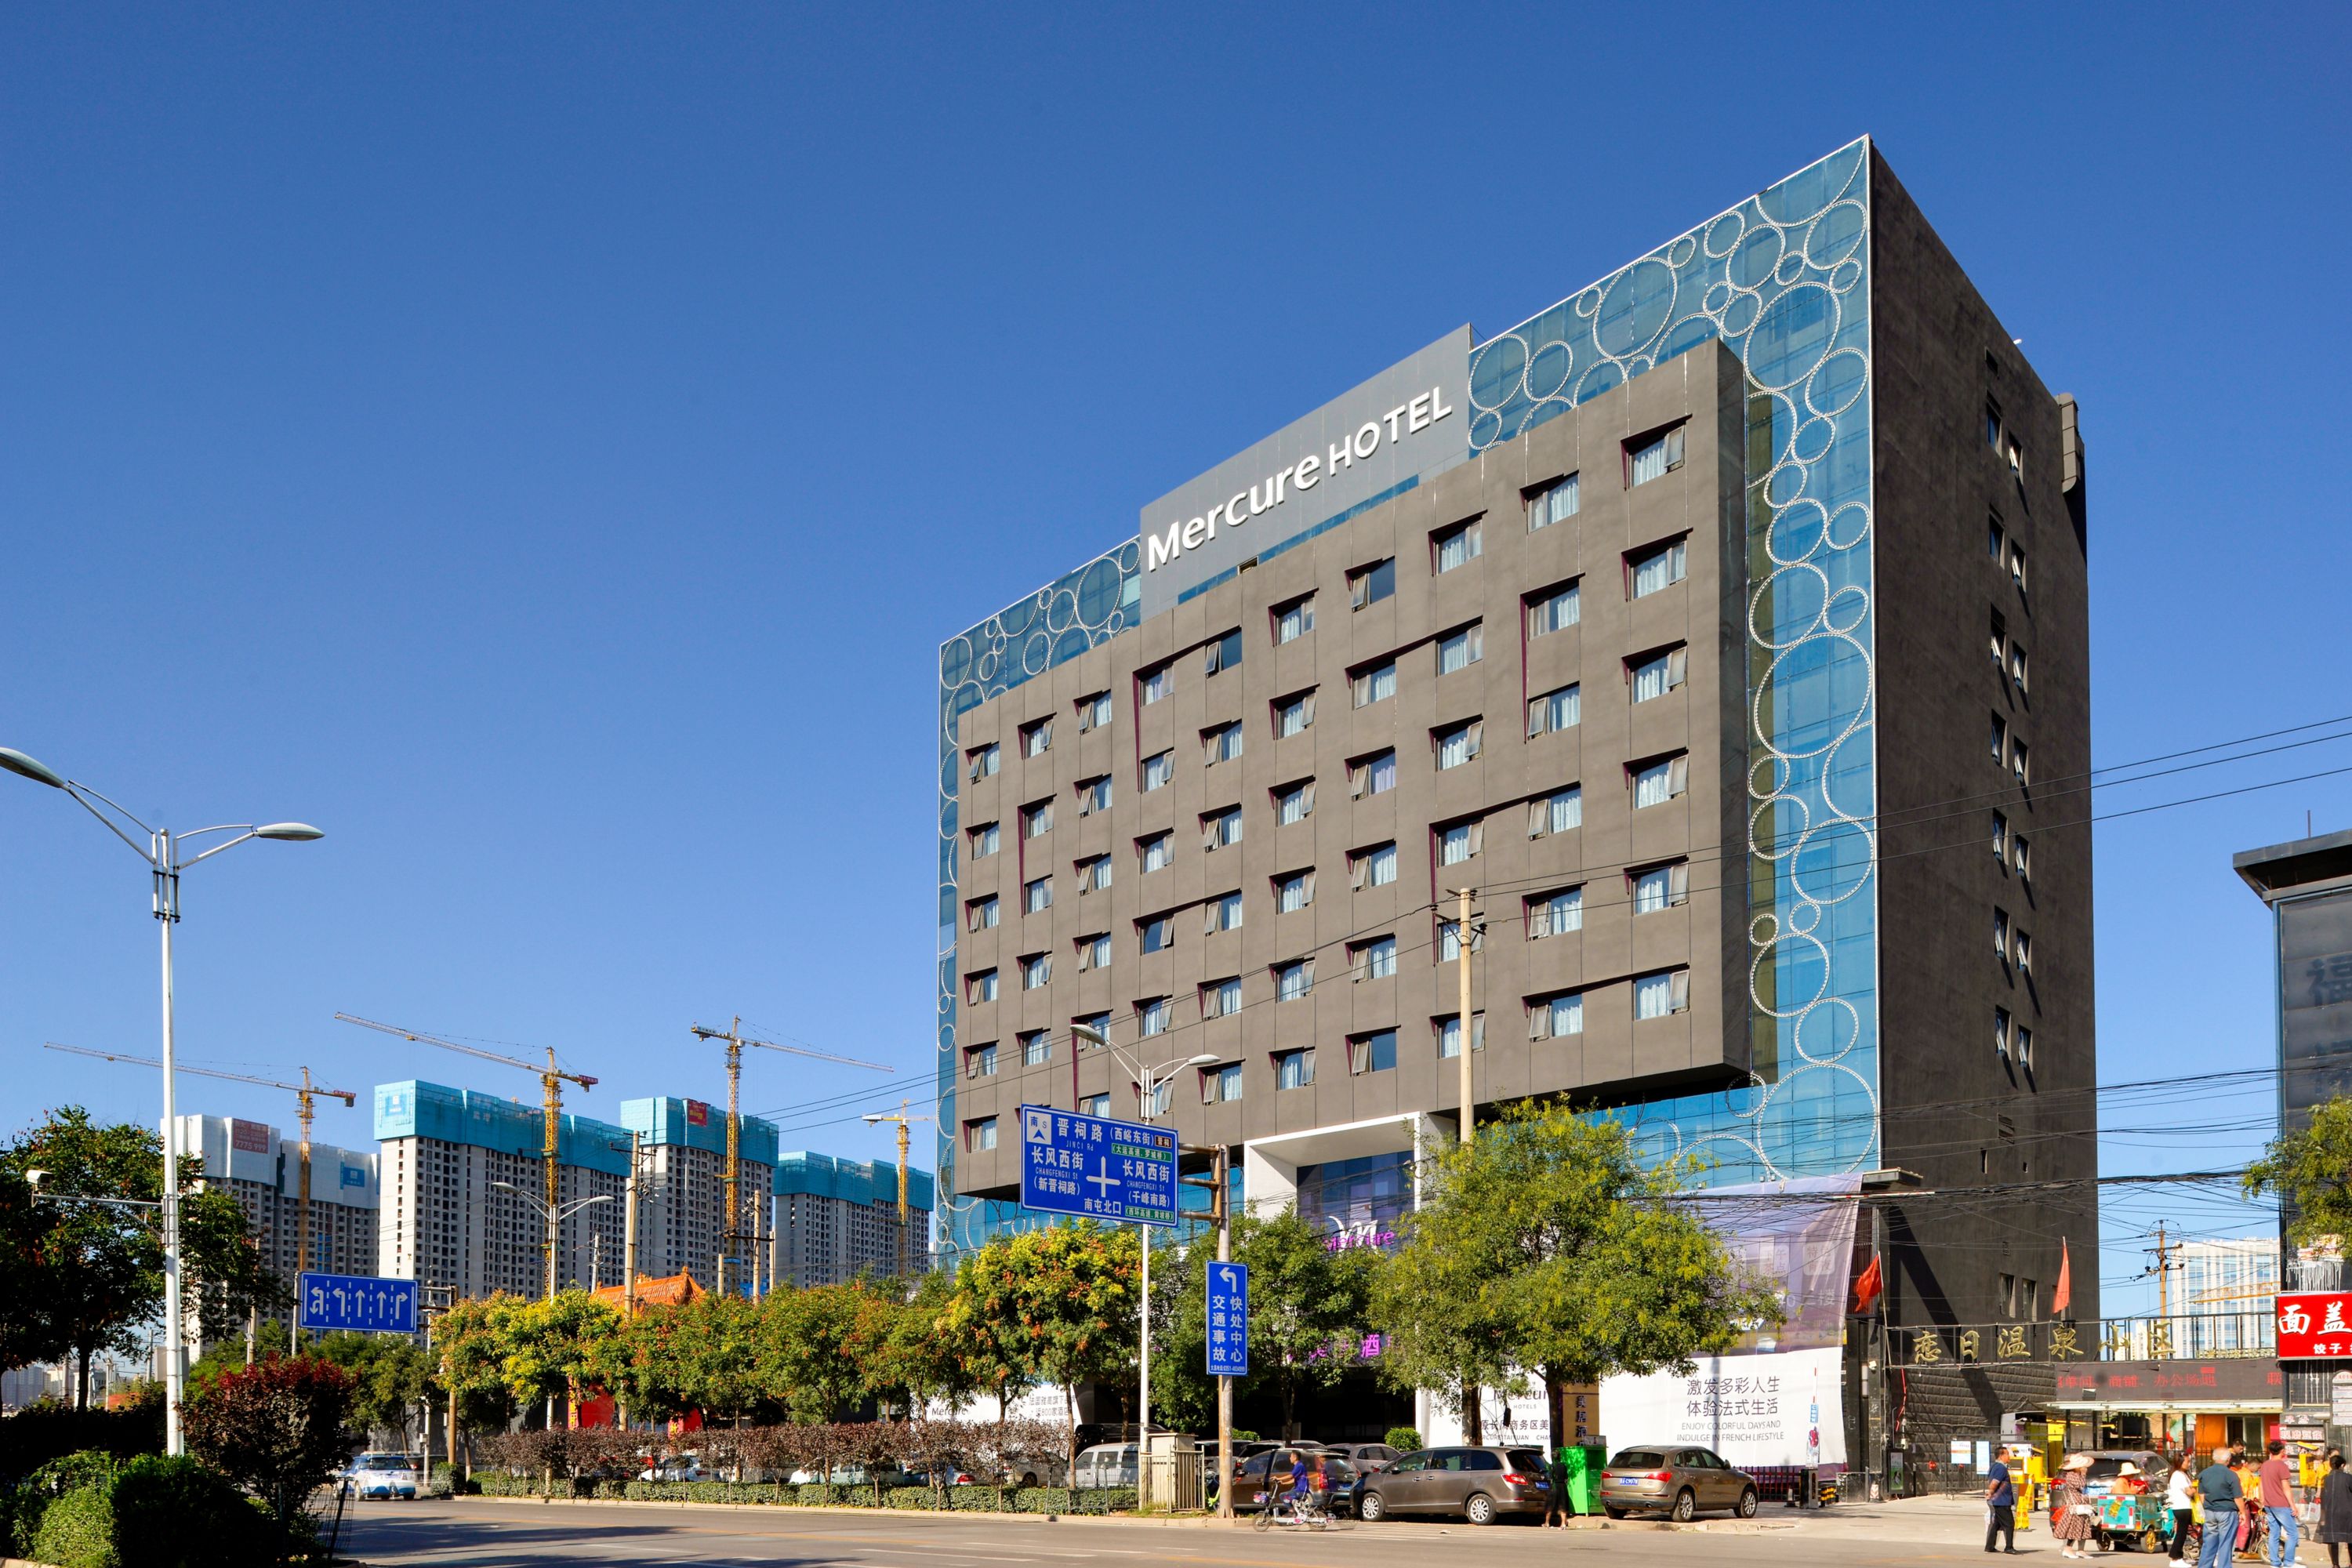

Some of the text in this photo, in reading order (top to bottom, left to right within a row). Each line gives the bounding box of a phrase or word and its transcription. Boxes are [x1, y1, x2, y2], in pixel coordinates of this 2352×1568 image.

[1148, 387, 1453, 572] Mercure HOTEL
[1030, 1116, 1038, 1127] 南
[1042, 1120, 1047, 1129] S
[1057, 1117, 1102, 1142] 晋祠路
[1032, 1145, 1083, 1171] 长风西街
[1035, 1167, 1070, 1179] CHANGFENGXI
[1123, 1159, 1170, 1183] 长风西街
[1127, 1180, 1157, 1191] CHANGFENGXI
[1084, 1197, 1121, 1214] 南屯北口
[1212, 1294, 1226, 1362] 交通事故
[1230, 1296, 1243, 1363] 快处中心
[1913, 1319, 2176, 1364] 恋日温泉小区
[2313, 1343, 2343, 1355] 饺子
[1686, 1376, 1780, 1396] 激发多彩人生
[1686, 1397, 1779, 1417] 体验法式生活
[1707, 1421, 1746, 1431] COLORFUL
[1677, 1432, 1784, 1442] INDULGE IN FRENCH LIFESTYLE
